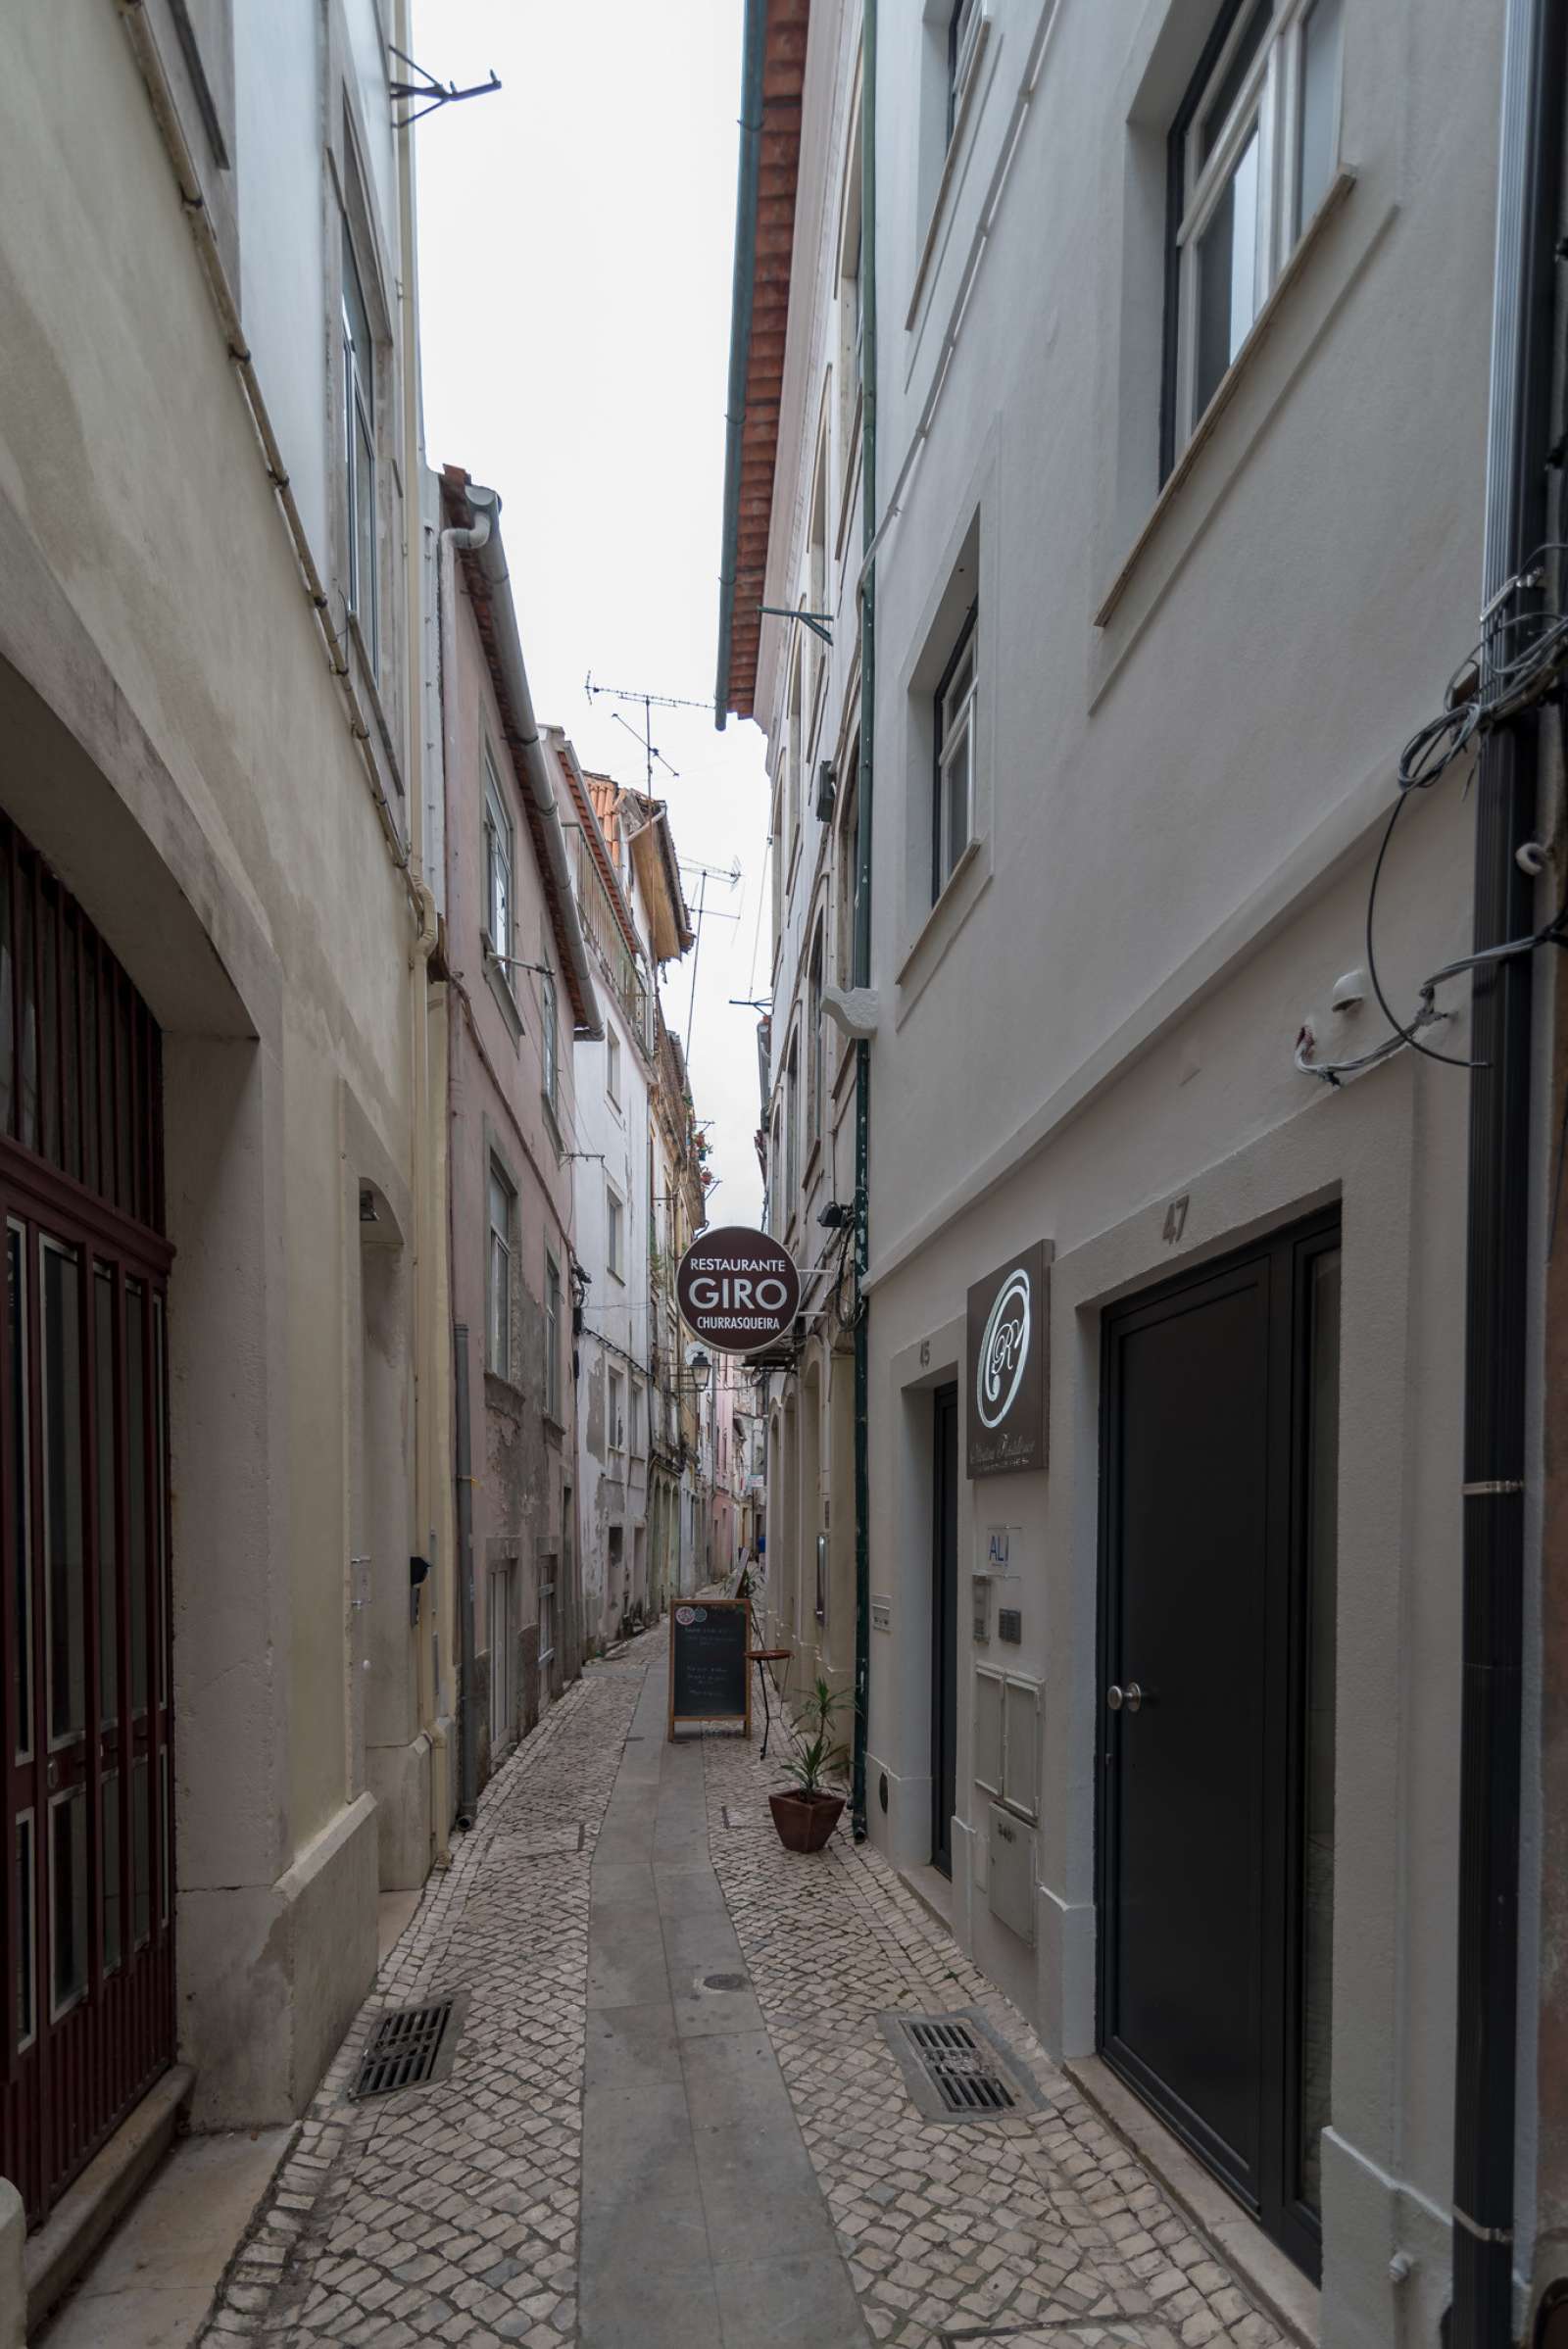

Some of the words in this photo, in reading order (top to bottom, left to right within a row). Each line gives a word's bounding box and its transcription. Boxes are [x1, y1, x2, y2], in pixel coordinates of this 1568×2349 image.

[1162, 1194, 1190, 1246] 47
[690, 1258, 786, 1272] RESTAURANTE
[689, 1277, 788, 1311] GIRO
[697, 1316, 780, 1330] CHURRASQUEIRA
[919, 1340, 931, 1367] 45
